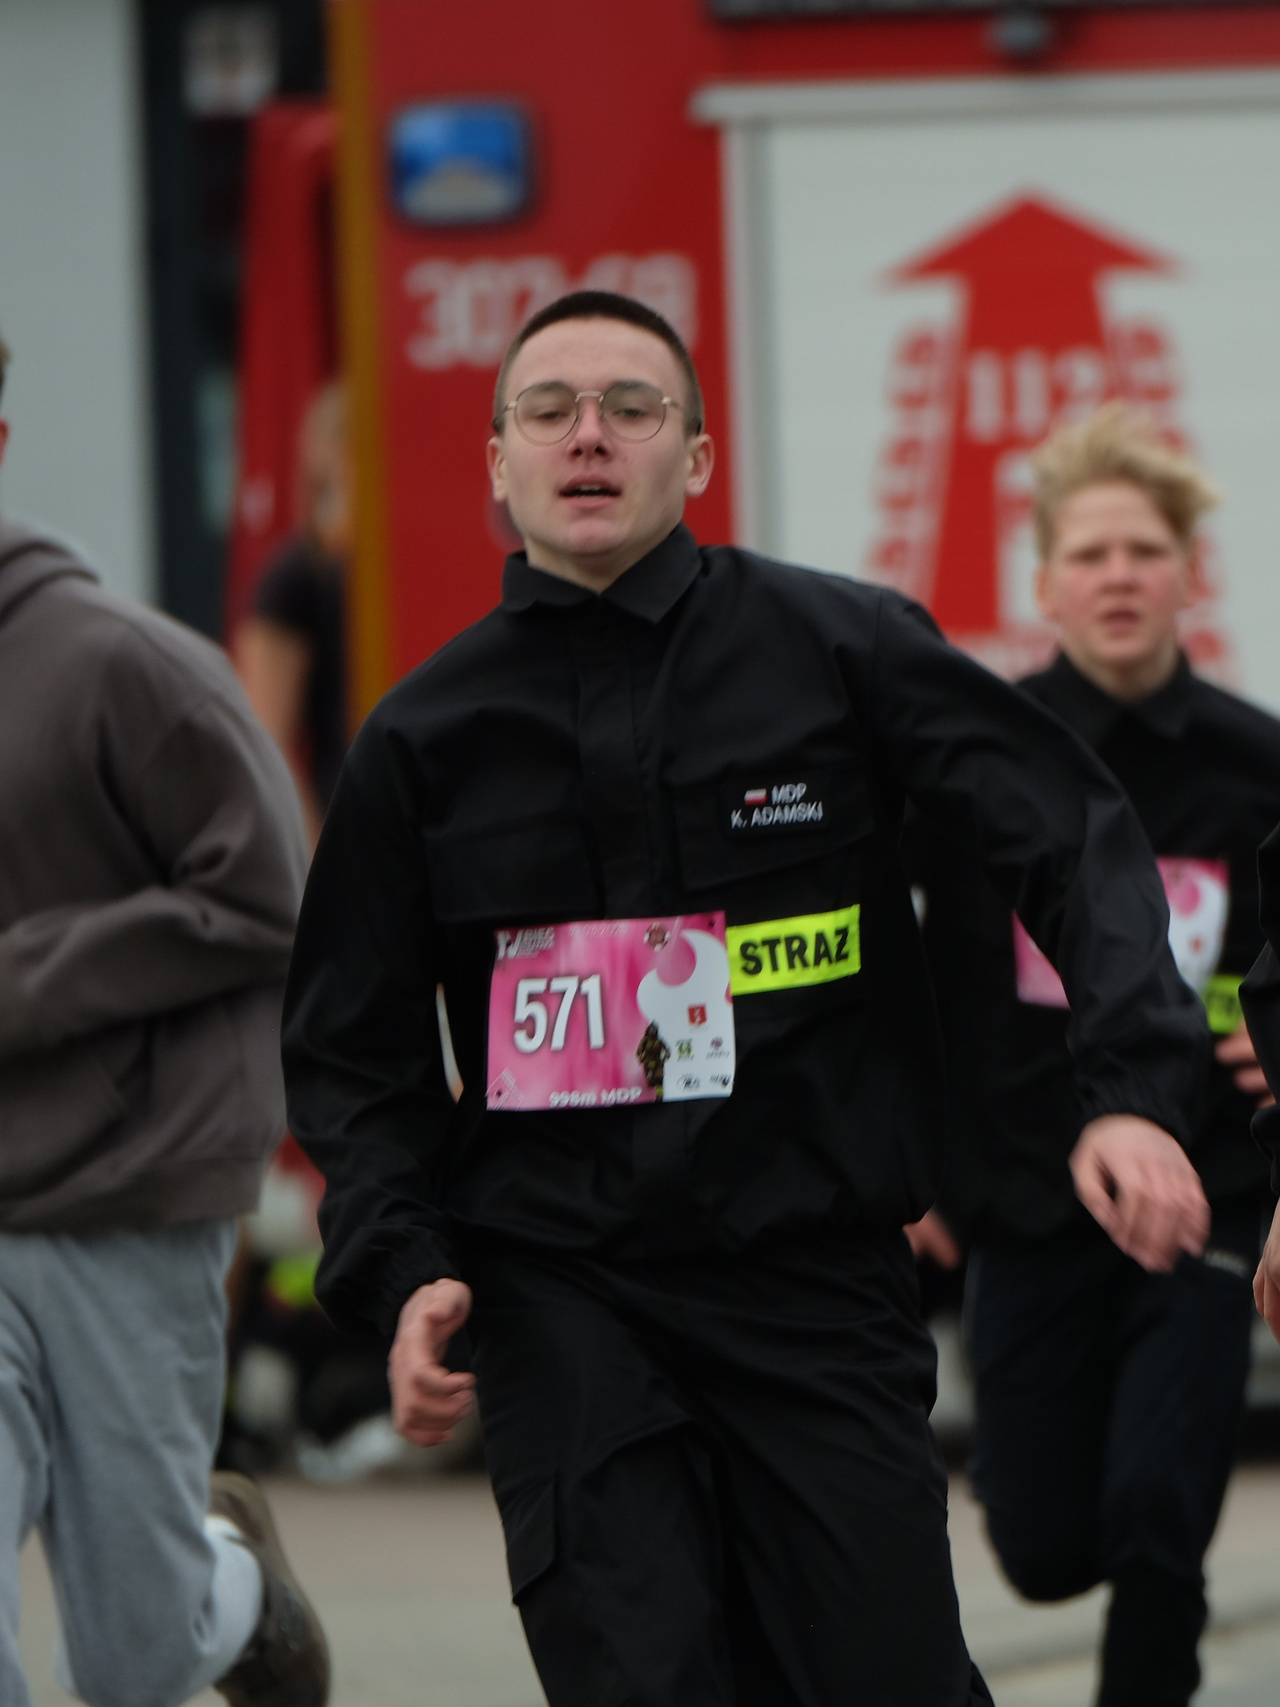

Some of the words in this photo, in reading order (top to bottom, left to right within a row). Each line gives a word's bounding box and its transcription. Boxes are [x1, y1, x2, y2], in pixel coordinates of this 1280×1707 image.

[771, 782, 807, 805] MDP
[750, 801, 824, 827] ADAMSKI
[513, 973, 605, 1054] 571
[600, 1086, 643, 1105] MDP
